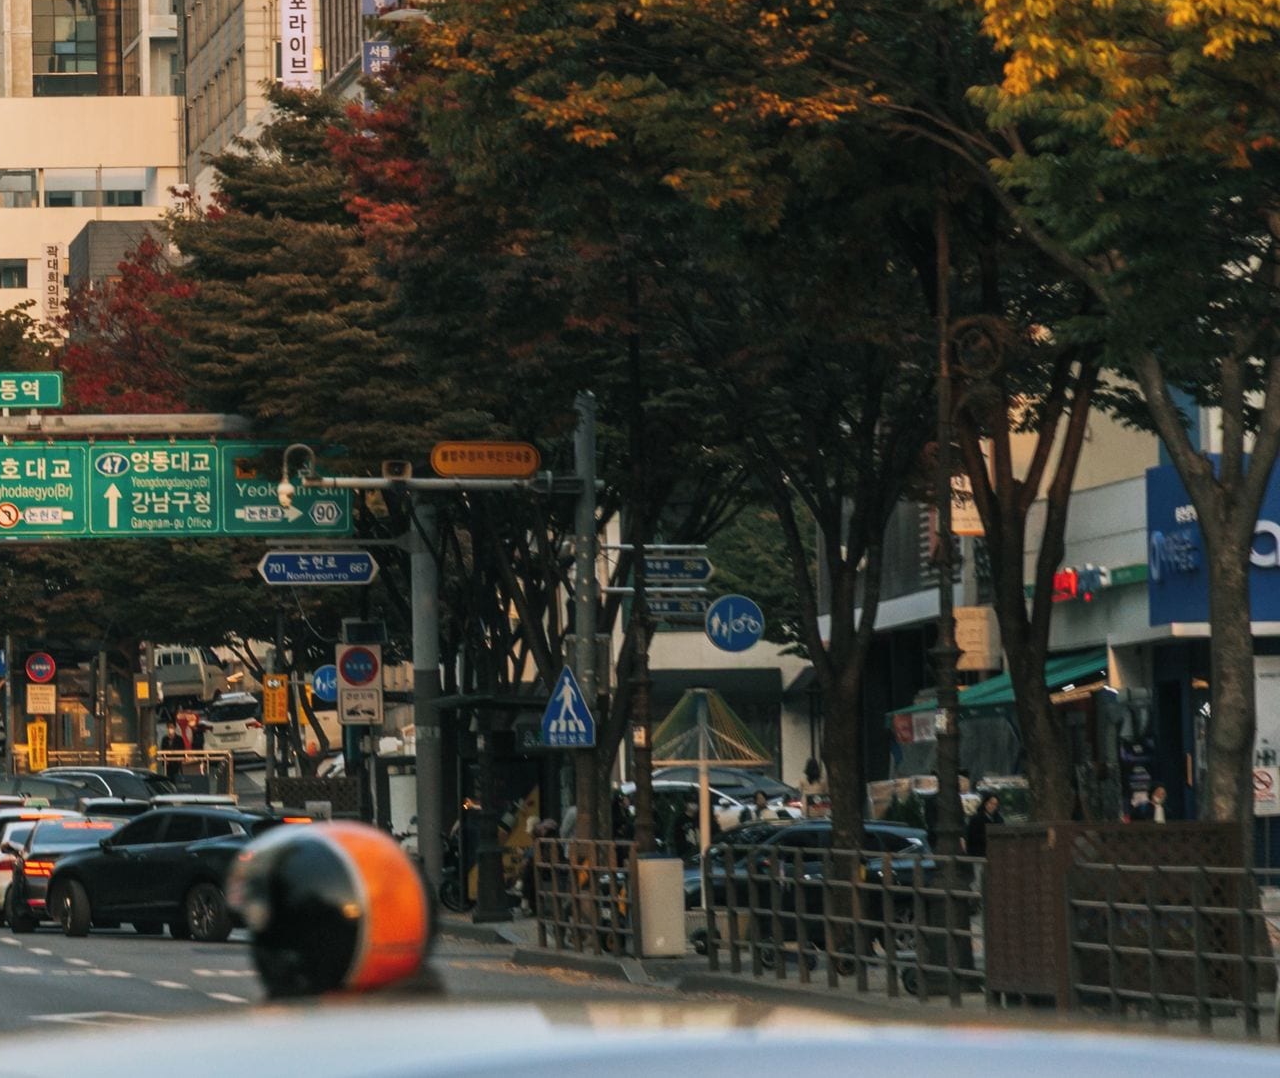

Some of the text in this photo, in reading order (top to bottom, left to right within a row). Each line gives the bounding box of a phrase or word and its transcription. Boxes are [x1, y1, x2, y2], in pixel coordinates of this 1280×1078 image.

[101, 456, 123, 474] 47
[130, 451, 211, 472] 영동대교
[131, 491, 211, 514] 강남구청
[315, 505, 335, 521] 90
[130, 517, 212, 531] Gangnam-gu Office
[268, 563, 286, 574] 701
[296, 555, 338, 570] 논현로
